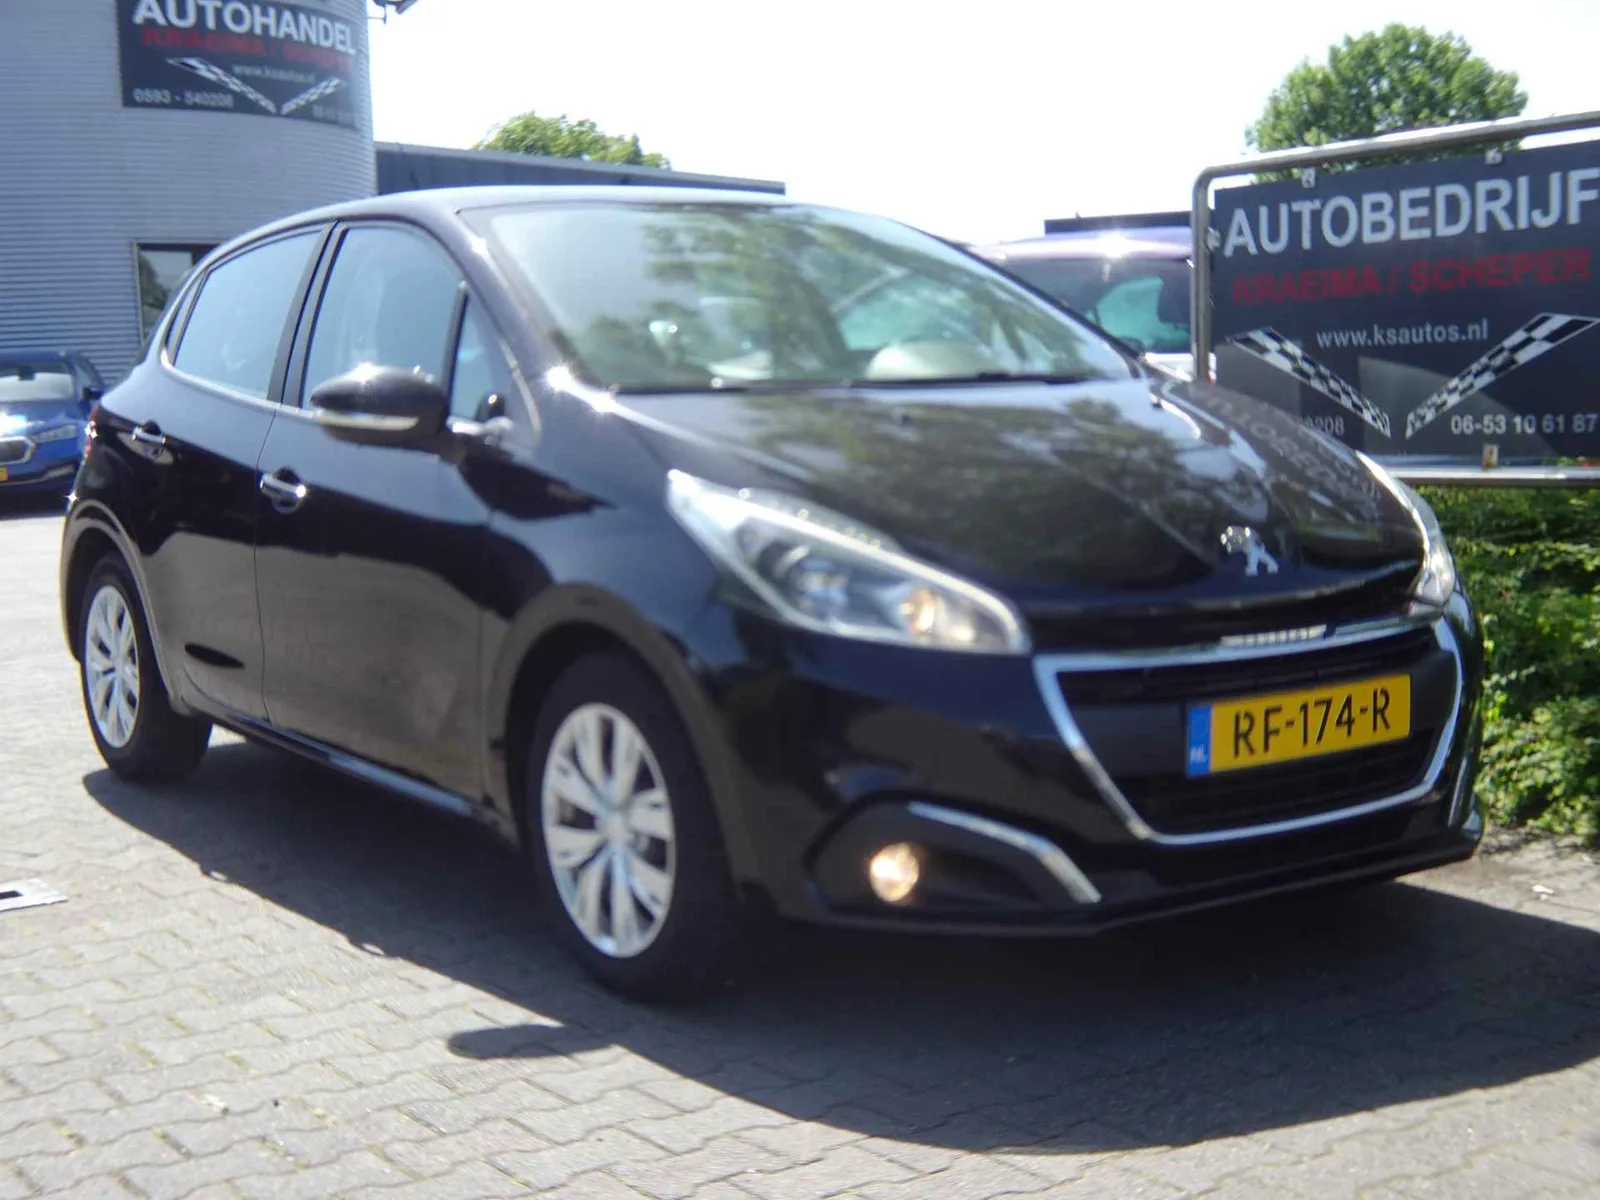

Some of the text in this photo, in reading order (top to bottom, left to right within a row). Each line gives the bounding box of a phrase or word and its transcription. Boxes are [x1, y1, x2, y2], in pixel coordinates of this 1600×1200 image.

[132, 0, 357, 55] AUTOHANDEL
[1223, 167, 1600, 258] AUTOBEDRIJF
[1232, 266, 1381, 306] KRAEIMA
[1407, 248, 1592, 294] SCHEPER
[1316, 318, 1489, 349] www.ksautos.nl
[1450, 413, 1507, 435] 06-53
[1513, 413, 1537, 435] 10
[1542, 413, 1565, 434] 61
[1572, 413, 1598, 434] 87
[1233, 688, 1391, 759] RF-174-R
